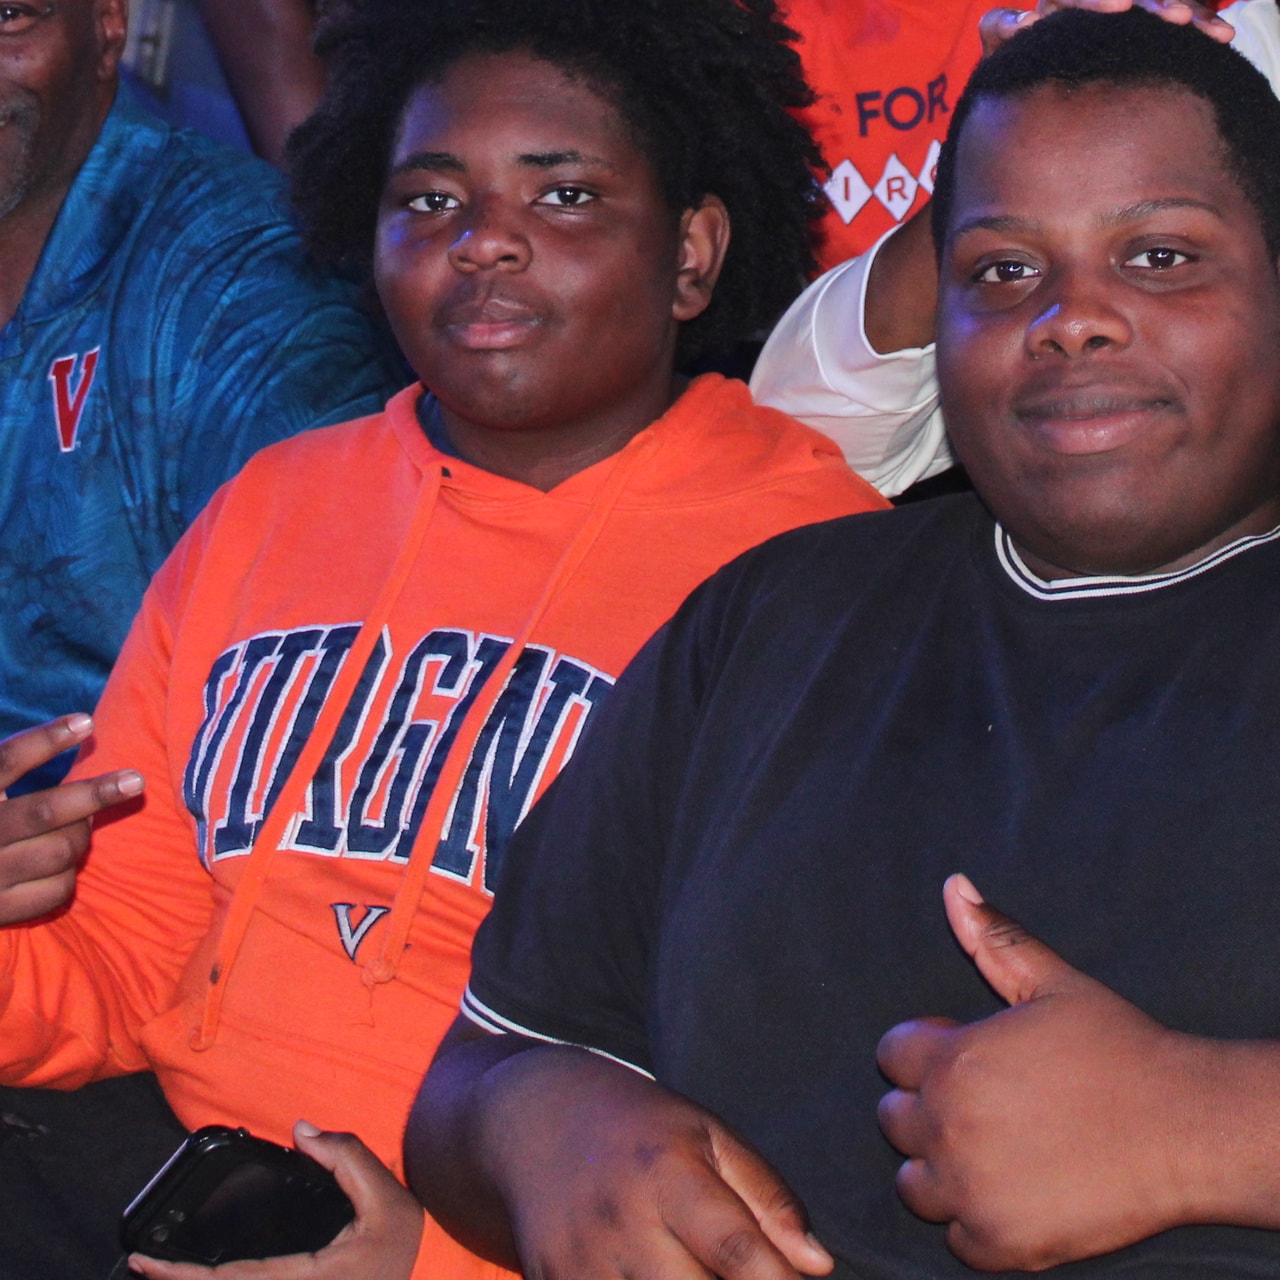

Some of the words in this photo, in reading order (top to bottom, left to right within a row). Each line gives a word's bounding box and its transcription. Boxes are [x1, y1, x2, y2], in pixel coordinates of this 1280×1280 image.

[856, 73, 949, 136] FOR
[47, 344, 100, 452] V
[183, 621, 617, 897] VIRGIN
[330, 902, 391, 961] V
